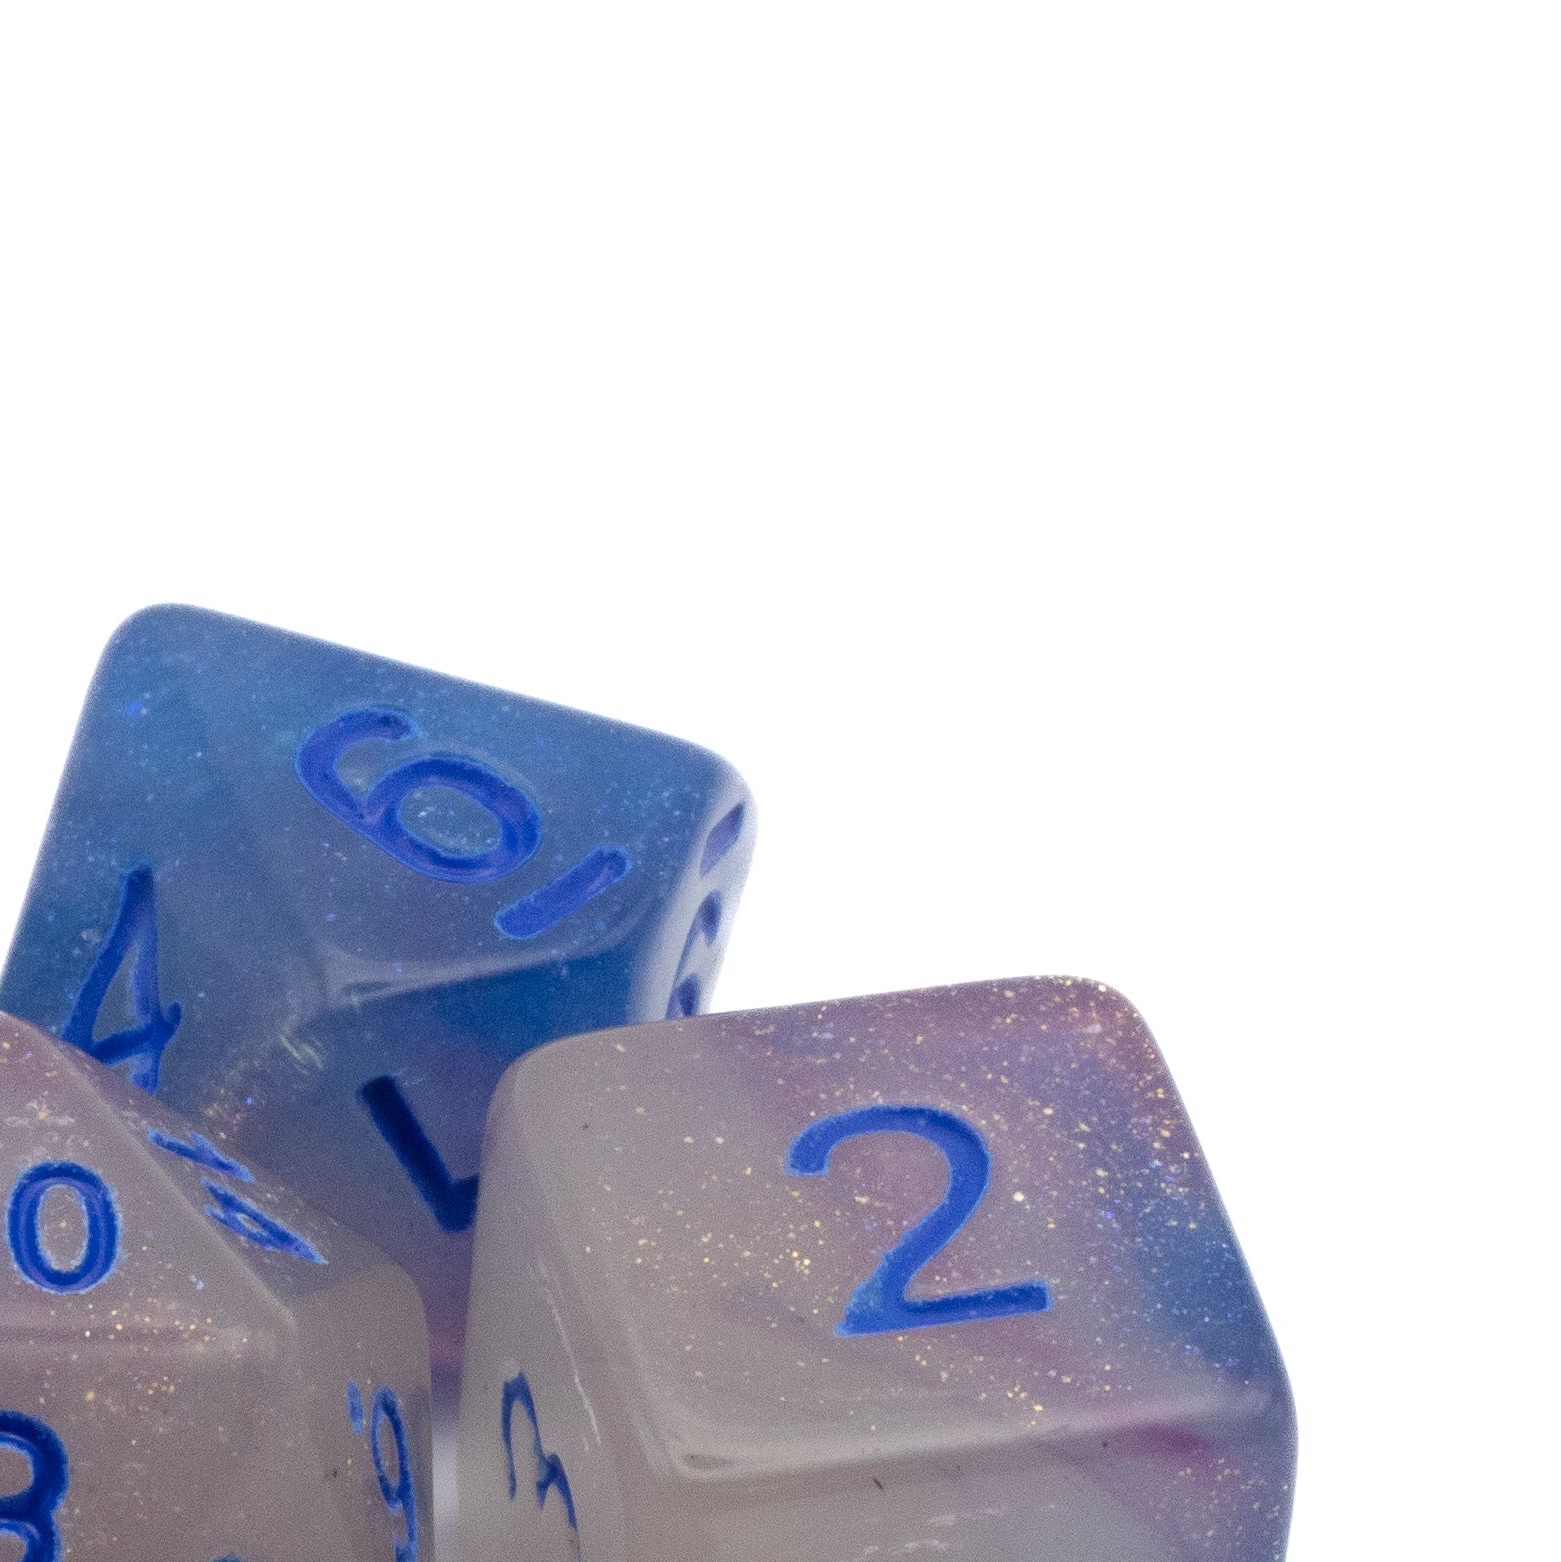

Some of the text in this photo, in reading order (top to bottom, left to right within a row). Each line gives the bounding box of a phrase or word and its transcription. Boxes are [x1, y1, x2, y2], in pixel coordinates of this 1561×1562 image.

[60, 862, 183, 1096] 4
[146, 1126, 330, 1267] 14
[785, 1103, 1053, 1338] 2
